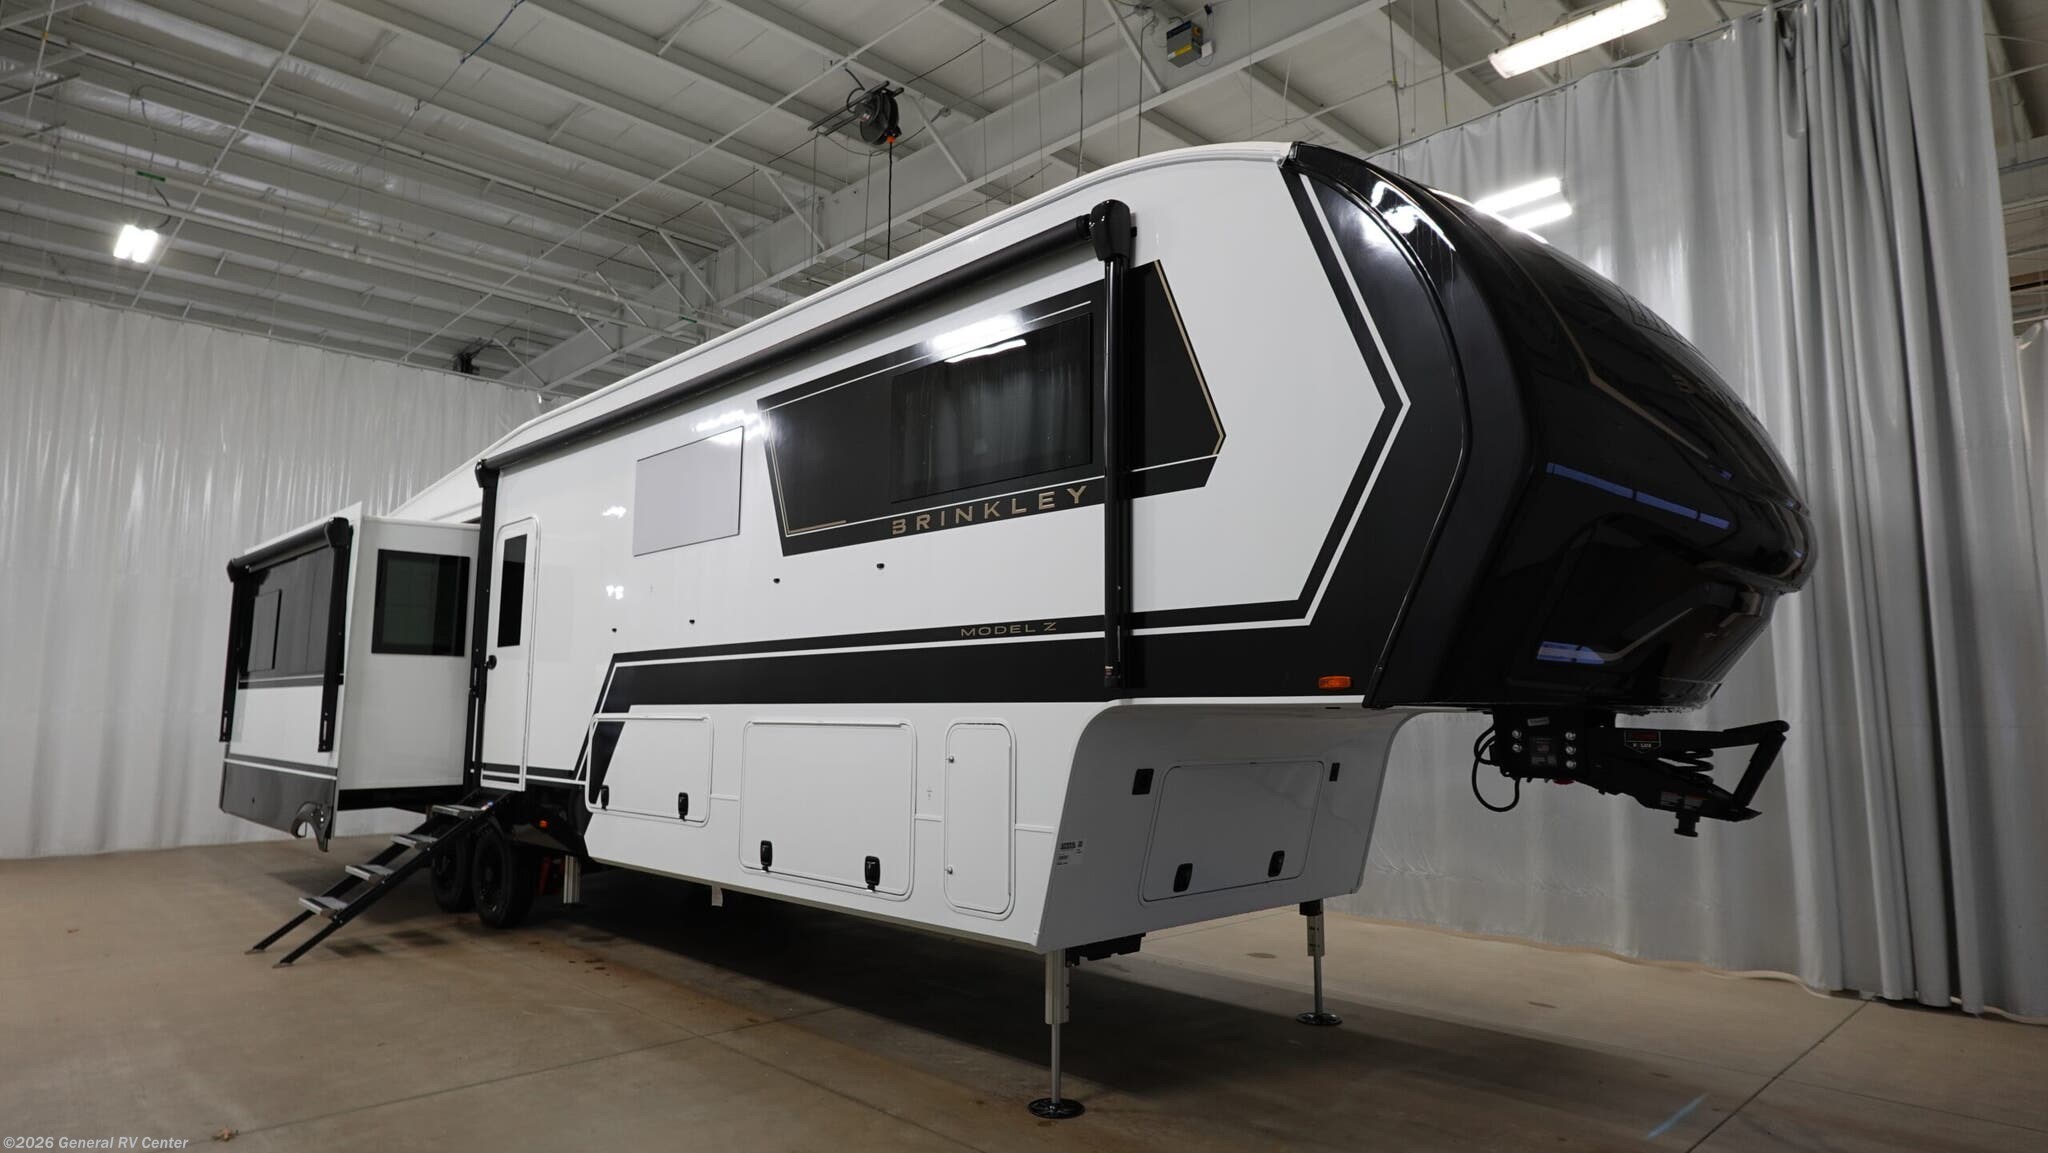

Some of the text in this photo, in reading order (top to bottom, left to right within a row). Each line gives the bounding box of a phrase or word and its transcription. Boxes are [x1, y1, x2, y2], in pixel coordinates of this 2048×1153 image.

[892, 485, 1087, 535] BRINKLEY
[960, 621, 1057, 638] MODEL Z
